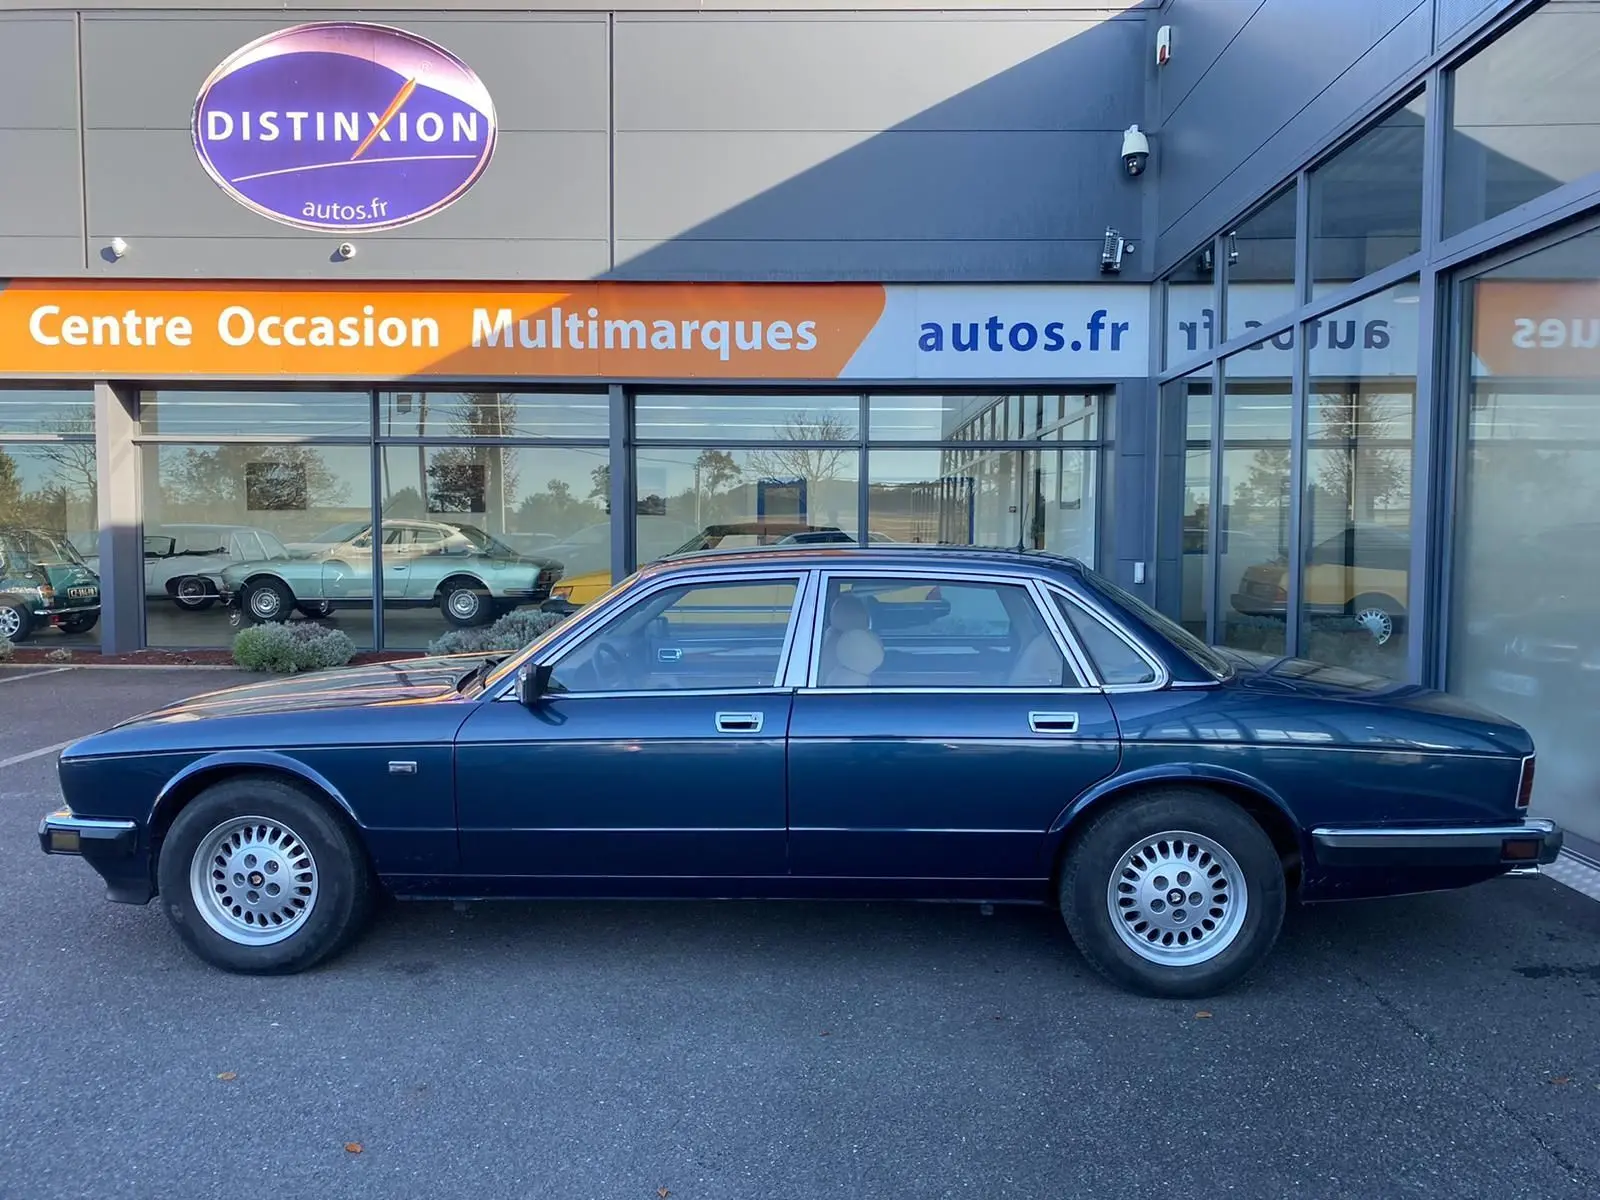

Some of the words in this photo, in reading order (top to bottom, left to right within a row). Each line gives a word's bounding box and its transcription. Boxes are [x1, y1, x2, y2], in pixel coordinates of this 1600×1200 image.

[207, 110, 478, 143] DISTINXION
[301, 197, 389, 221] autos.fr
[29, 305, 193, 348] Centre
[217, 305, 440, 348] Occasion
[471, 306, 819, 361] Multimarques
[918, 309, 1129, 352] autos.fr
